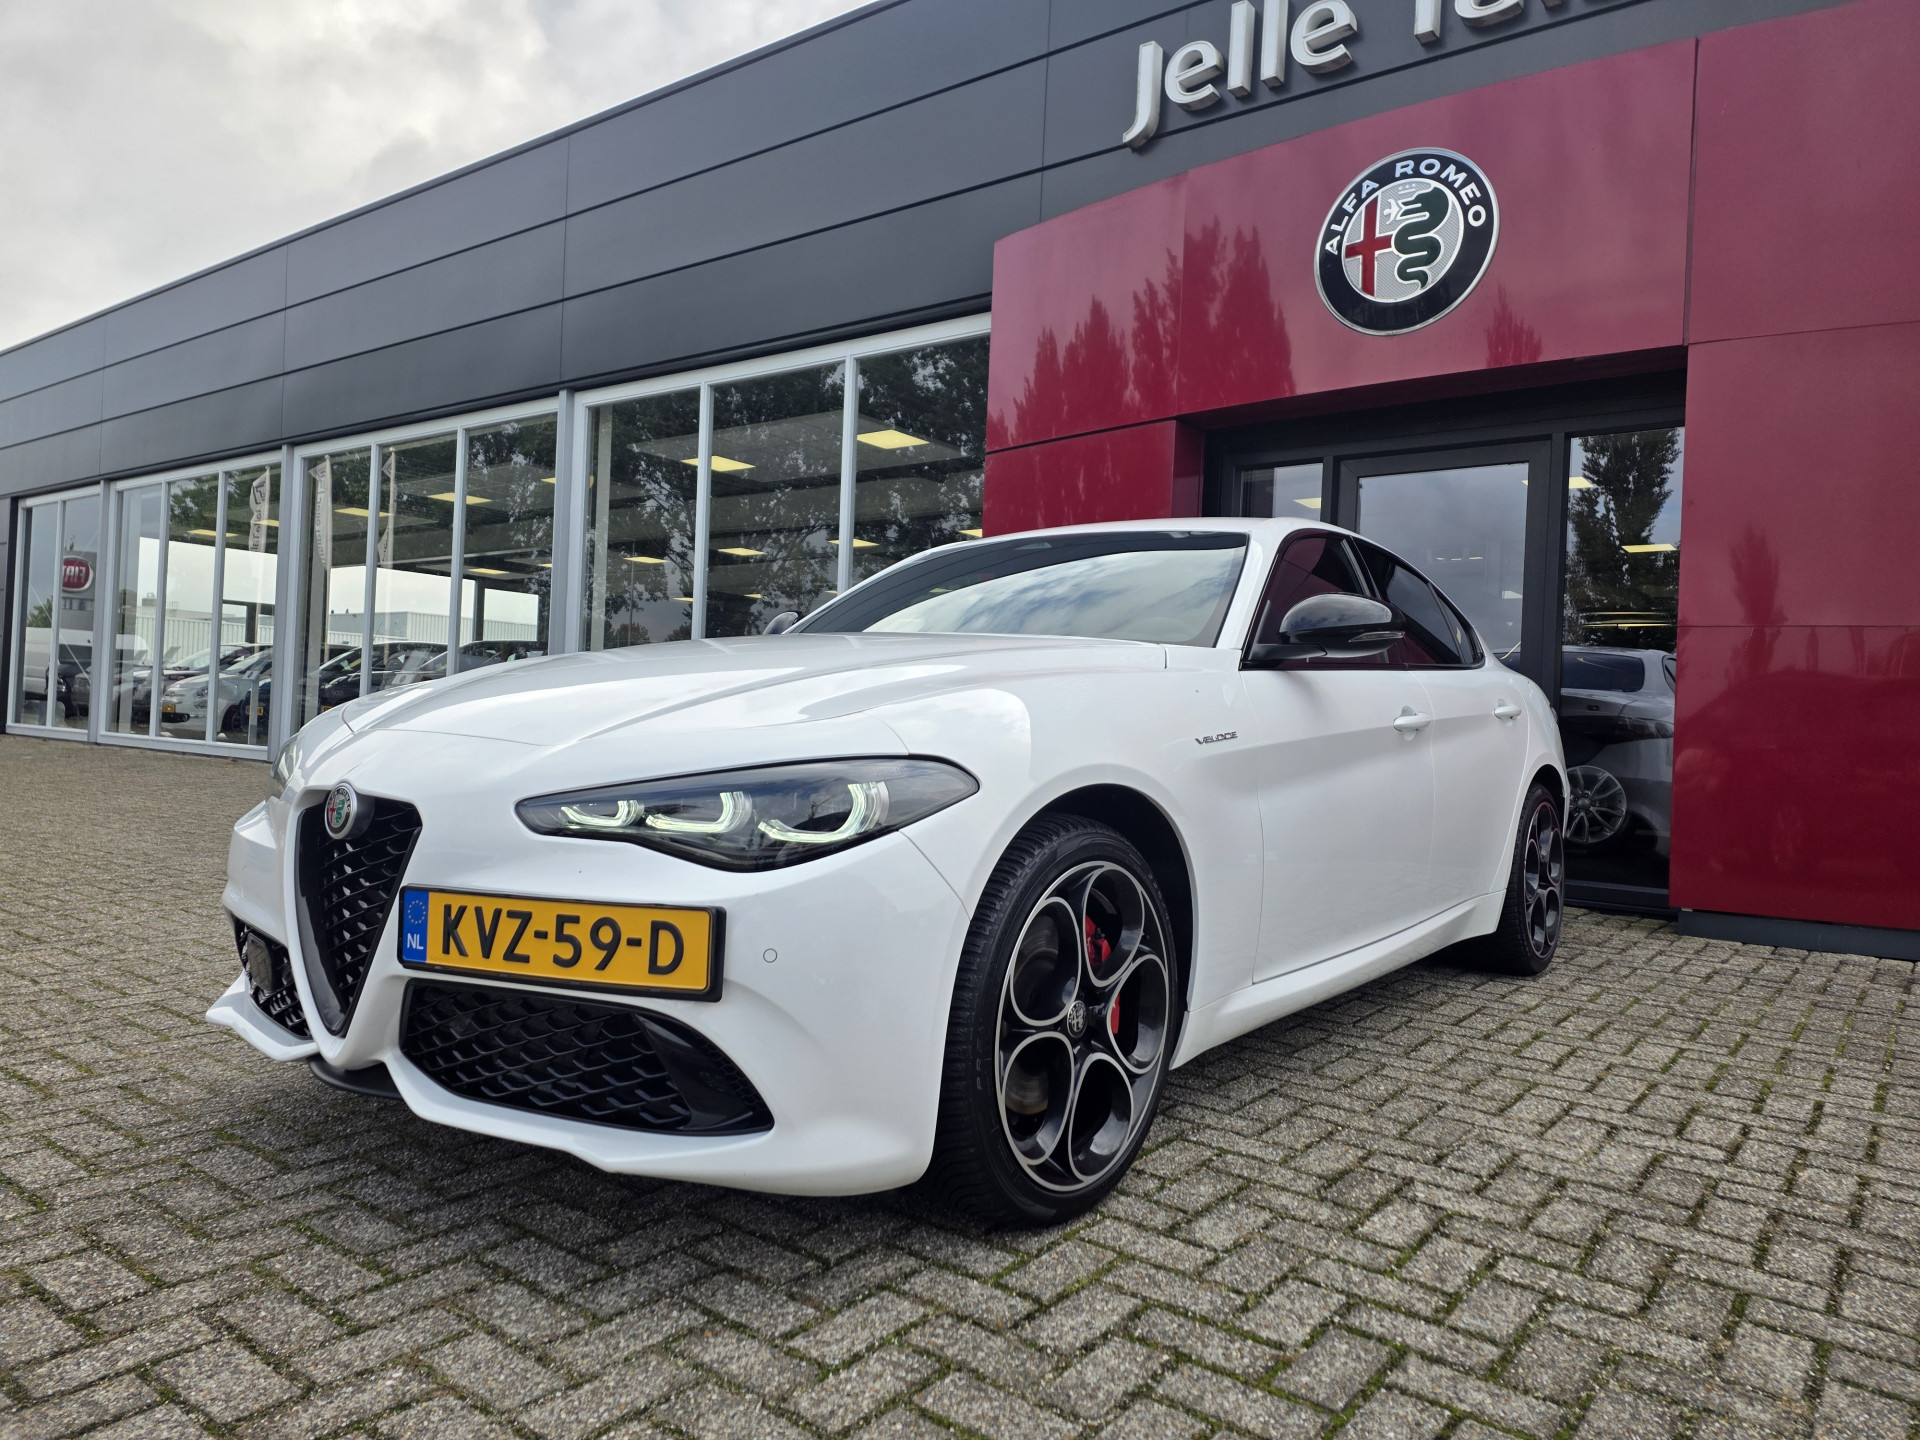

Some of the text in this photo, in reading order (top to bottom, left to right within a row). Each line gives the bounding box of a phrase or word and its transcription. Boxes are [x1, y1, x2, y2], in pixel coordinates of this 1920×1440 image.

[1122, 0, 1358, 150] Jelle
[1325, 158, 1487, 255] ALFA ROMEO
[1194, 731, 1238, 745] VELOCE
[406, 932, 424, 950] NL
[441, 903, 685, 976] KVZ-59-D
